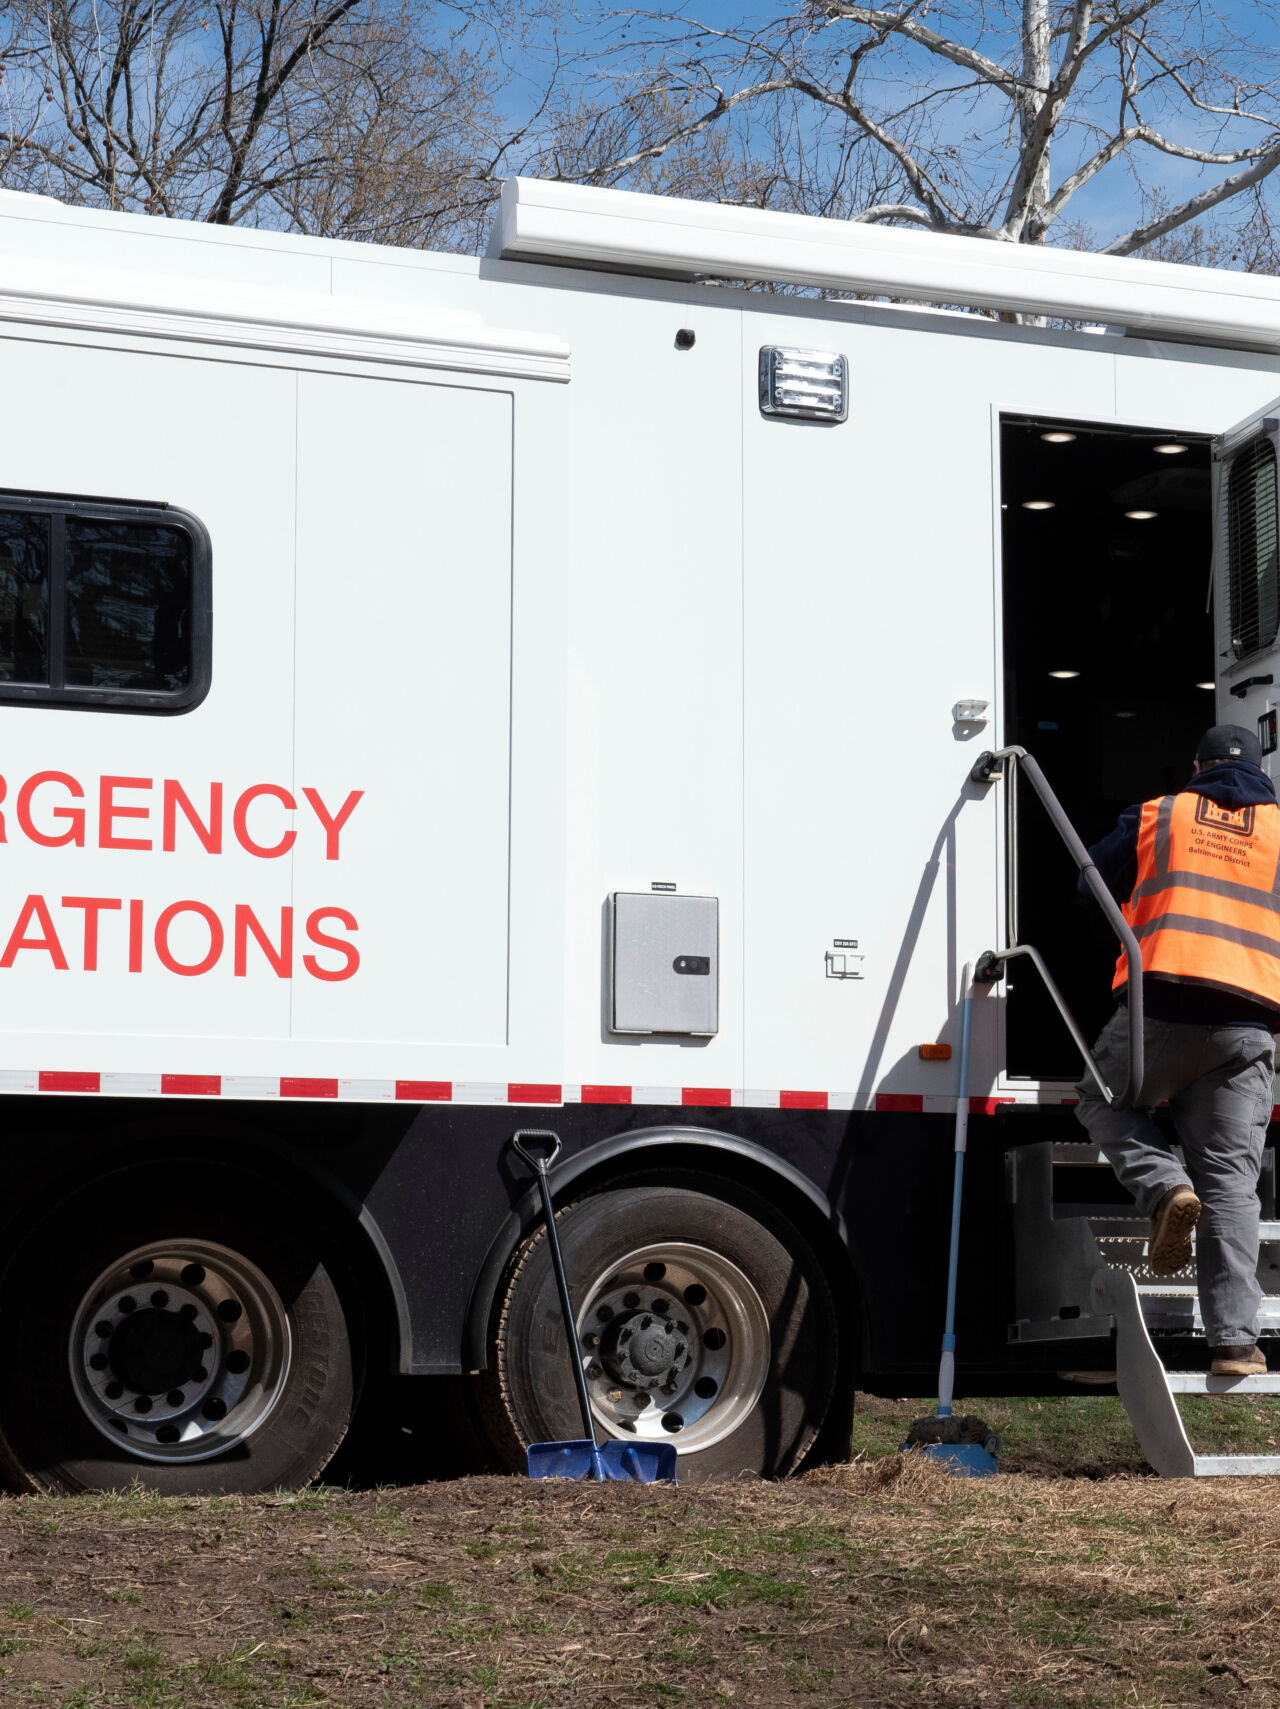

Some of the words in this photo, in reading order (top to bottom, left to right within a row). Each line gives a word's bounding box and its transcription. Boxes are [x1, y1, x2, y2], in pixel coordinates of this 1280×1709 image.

[0, 771, 365, 860] GENCY
[1207, 832, 1228, 841] ARMY
[1229, 837, 1253, 848] CORPS
[1207, 841, 1246, 856] ENGINEERS
[1189, 847, 1222, 859] Baltimore
[1224, 855, 1250, 867] District
[0, 894, 361, 982] ATIONS
